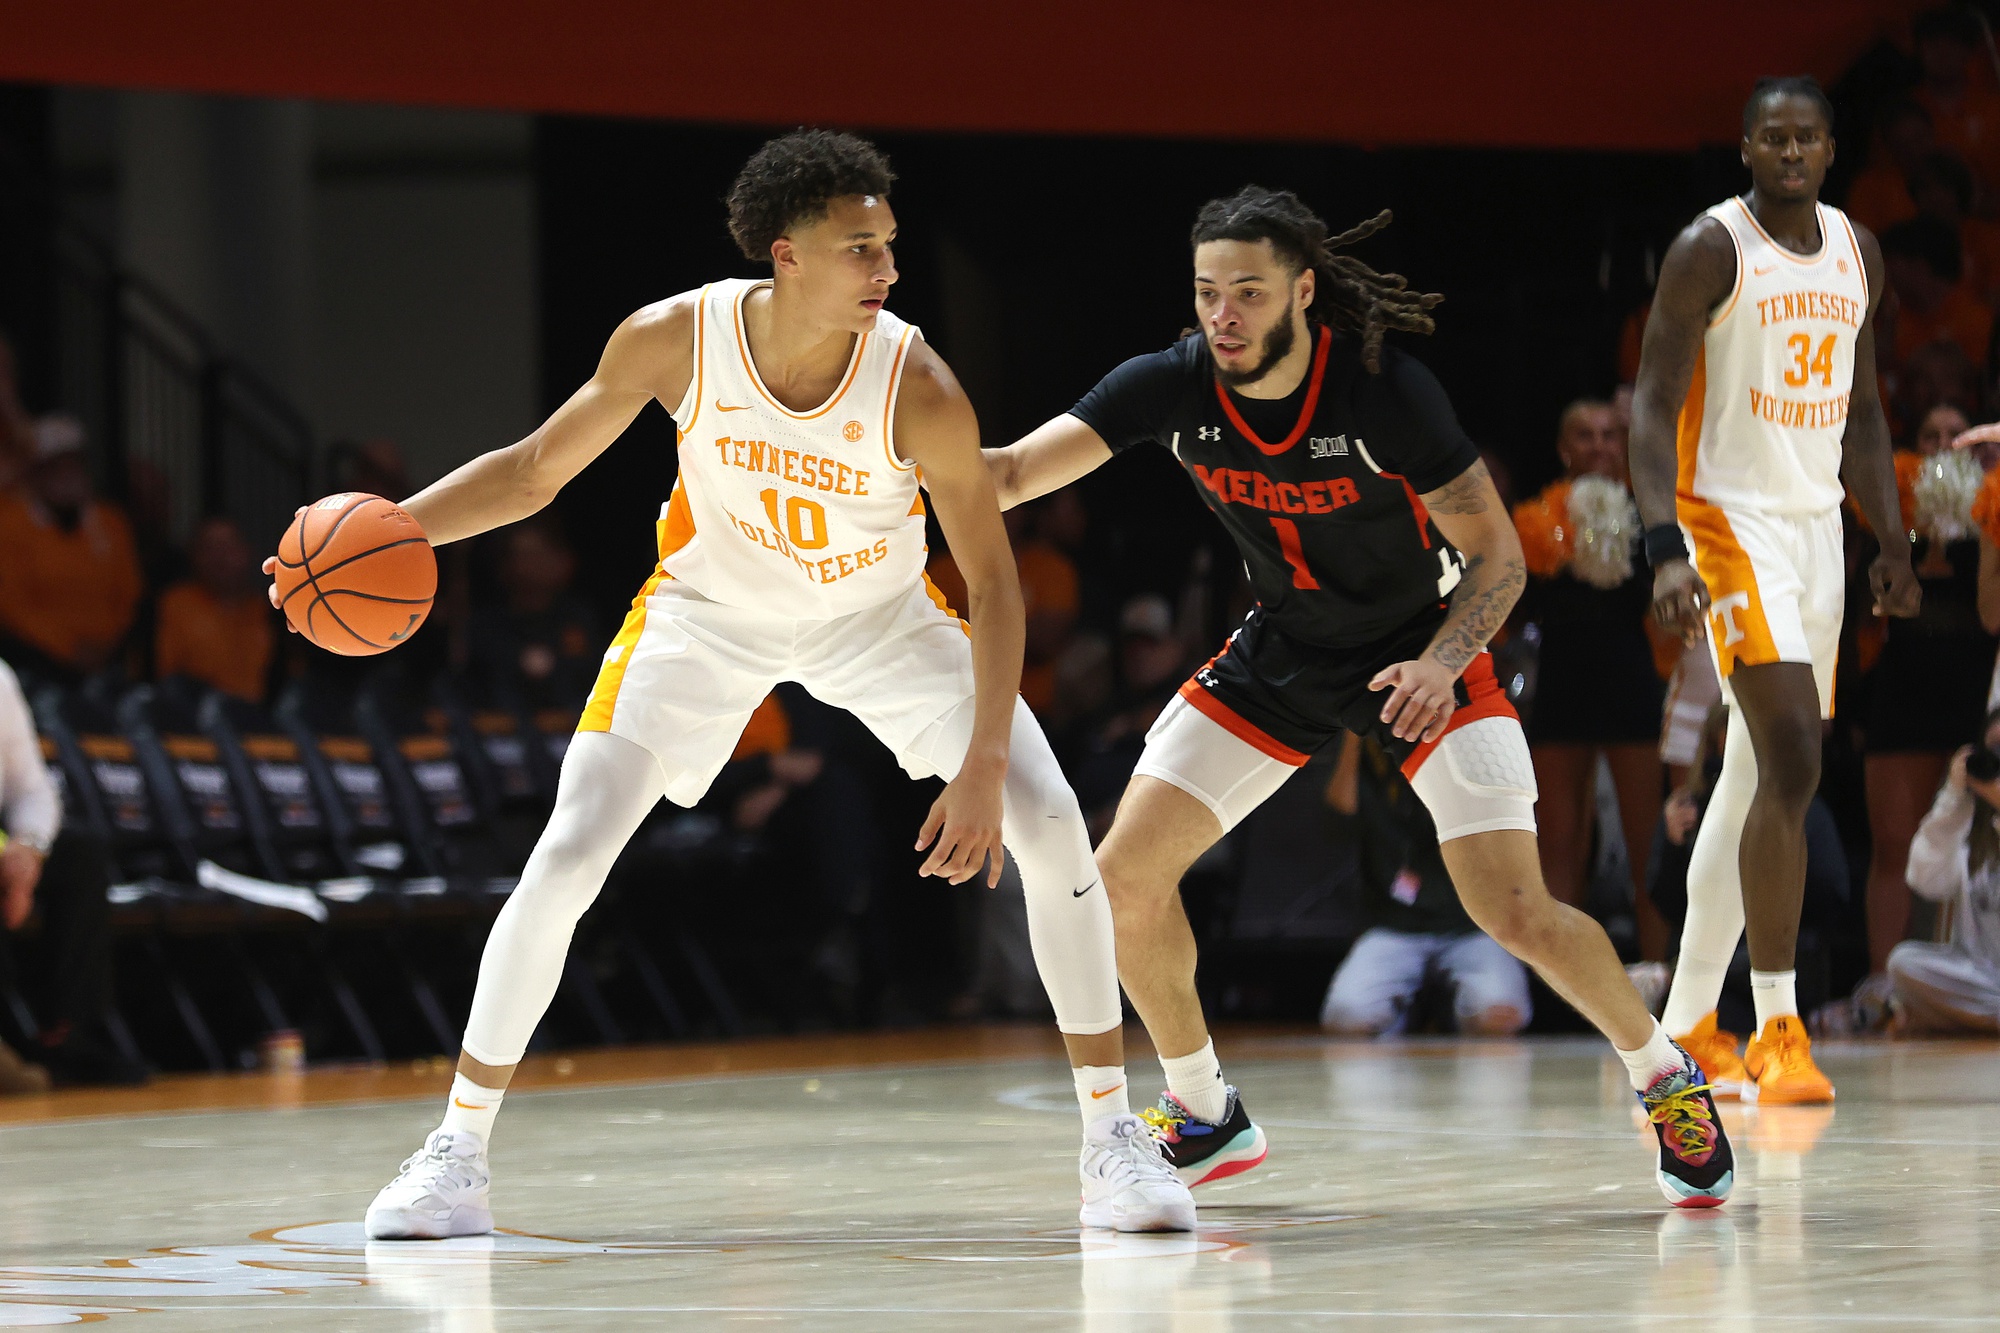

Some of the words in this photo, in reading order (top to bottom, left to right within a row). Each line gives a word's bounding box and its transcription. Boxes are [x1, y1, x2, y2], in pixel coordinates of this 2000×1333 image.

[1757, 290, 1859, 329] TENNESSEE
[1784, 332, 1838, 388] 34
[715, 436, 870, 496] TENNESSEE
[1192, 464, 1361, 514] MERCER
[760, 488, 829, 549] 10
[1268, 517, 1321, 590] 1
[1711, 590, 1749, 649] T
